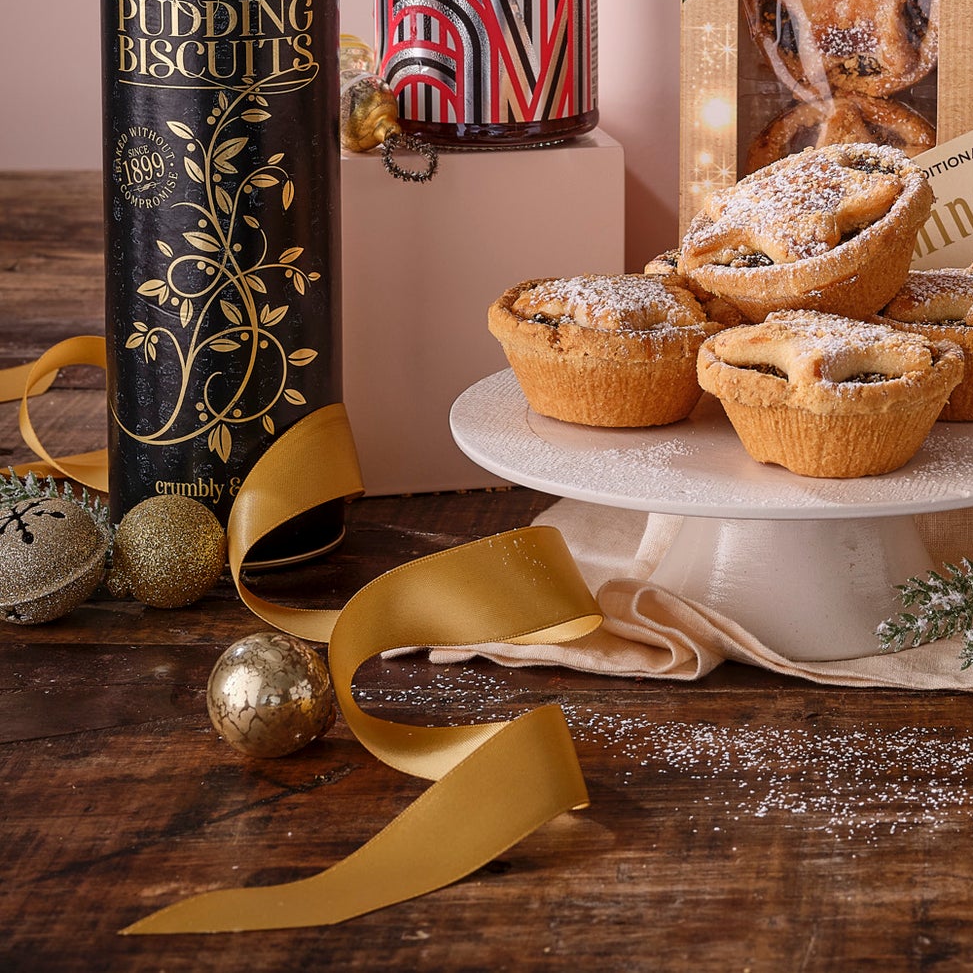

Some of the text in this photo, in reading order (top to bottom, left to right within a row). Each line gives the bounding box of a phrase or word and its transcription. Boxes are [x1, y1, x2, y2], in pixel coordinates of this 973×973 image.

[117, 33, 315, 79] BISCUITS
[115, 126, 176, 173] BAKED WITHOUT
[128, 144, 150, 158] SINCE
[122, 152, 165, 186] 1899
[120, 171, 179, 209] COMPROMISE
[155, 477, 225, 504] crumbly
